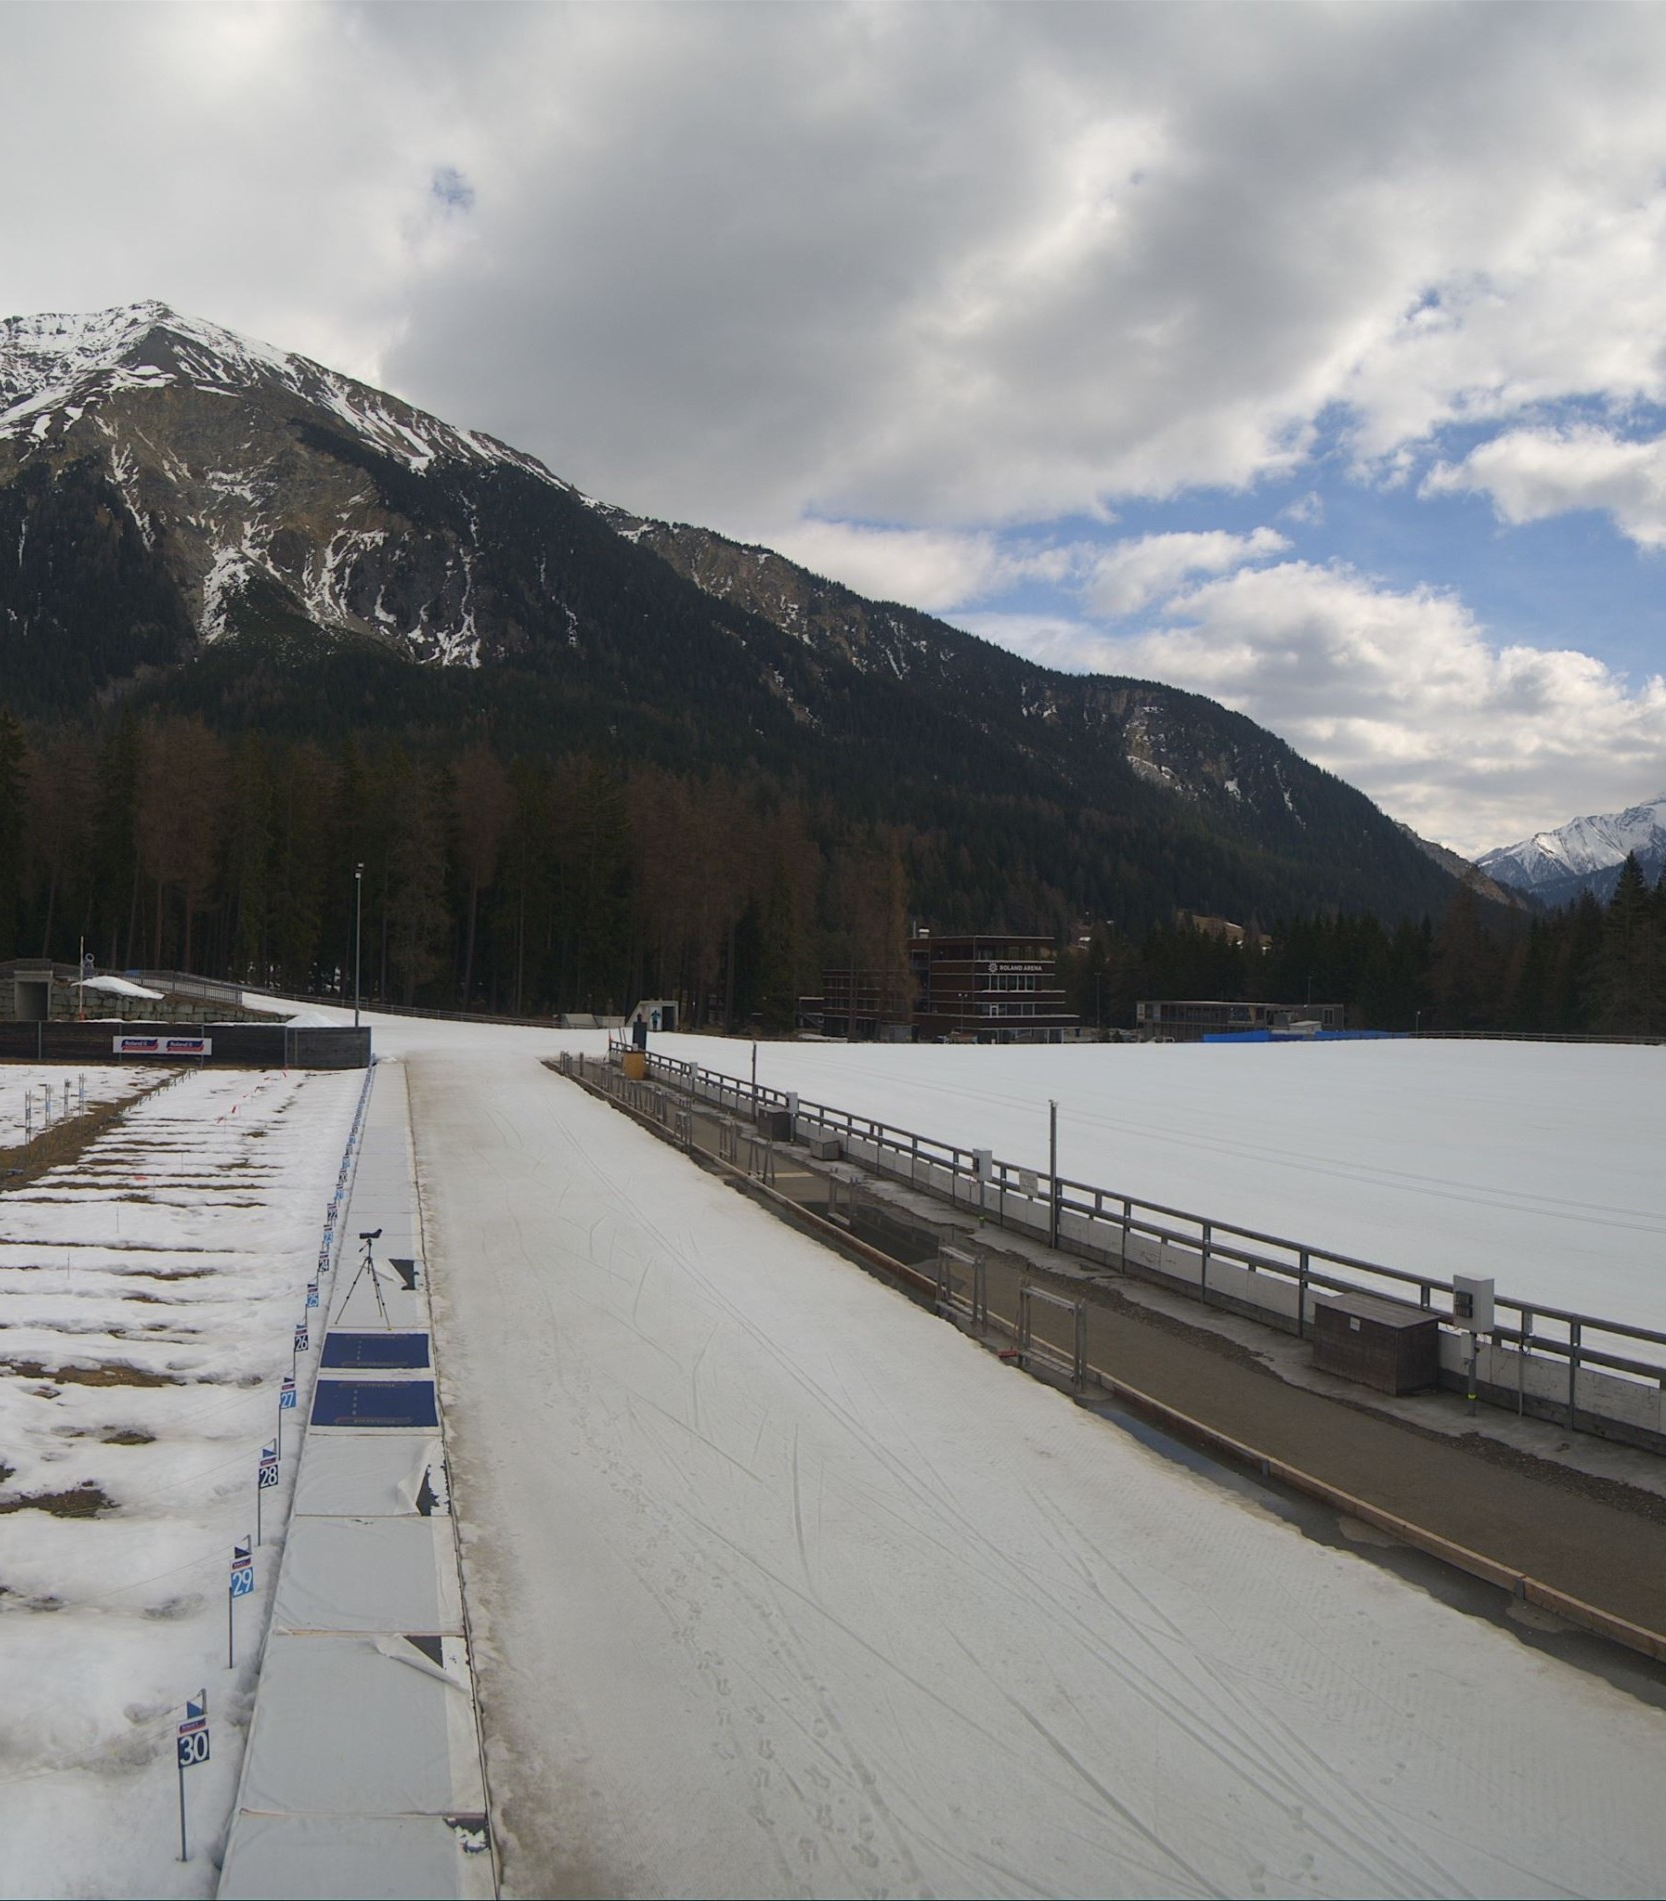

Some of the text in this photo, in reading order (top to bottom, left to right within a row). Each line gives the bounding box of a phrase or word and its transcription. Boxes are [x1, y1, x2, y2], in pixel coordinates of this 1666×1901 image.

[319, 1260, 329, 1272] 24
[308, 1294, 319, 1306] 25
[295, 1337, 307, 1350] 26
[282, 1392, 295, 1409] 27
[260, 1466, 277, 1488] 28
[233, 1568, 253, 1596] 29
[179, 1732, 208, 1766] 30
